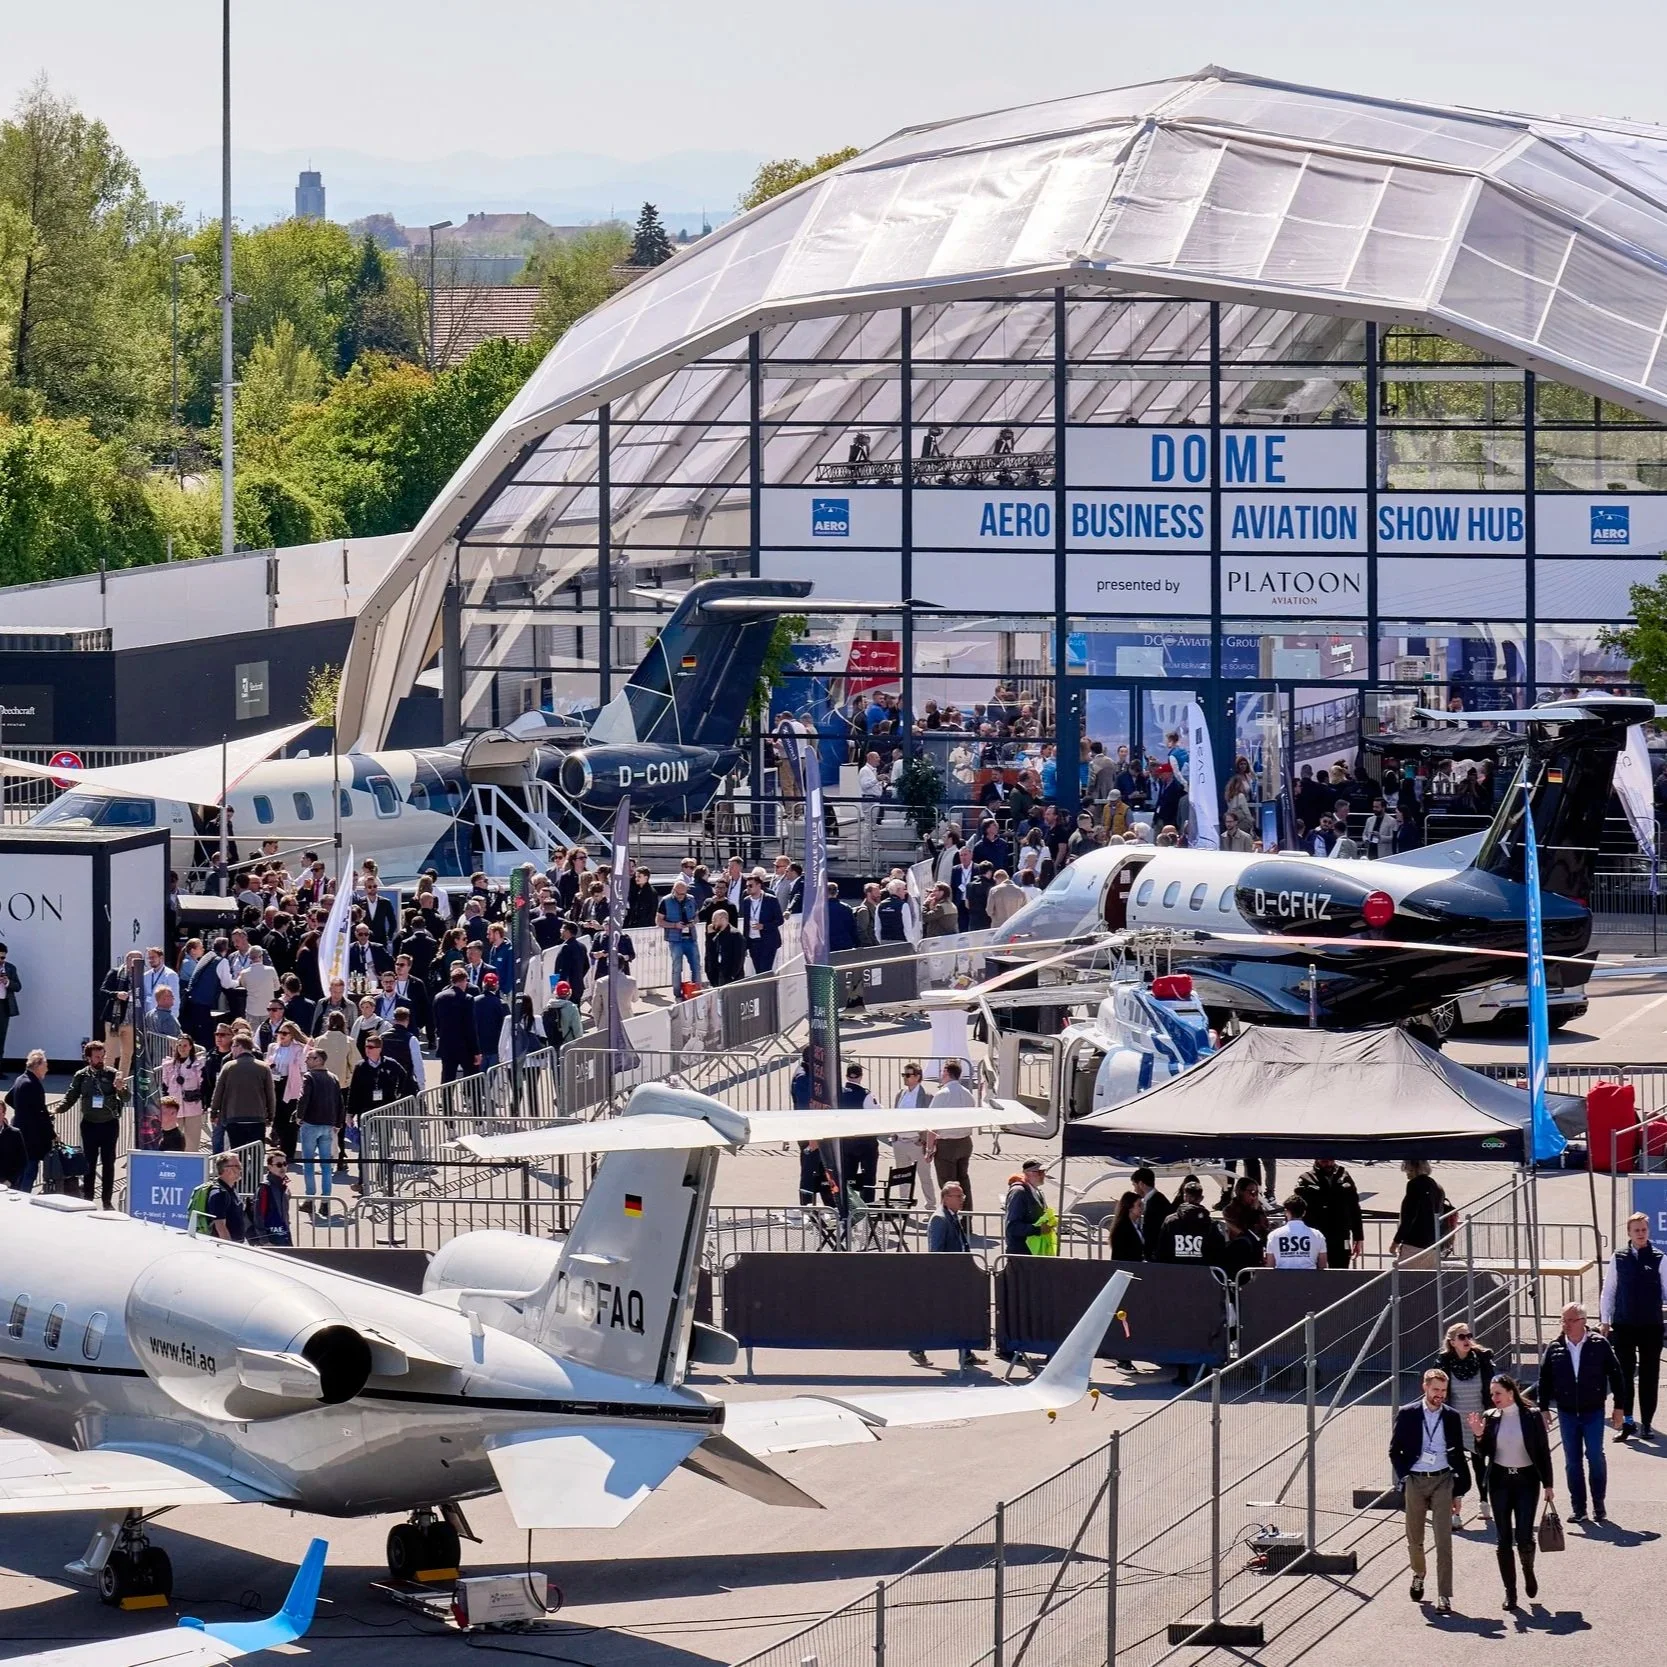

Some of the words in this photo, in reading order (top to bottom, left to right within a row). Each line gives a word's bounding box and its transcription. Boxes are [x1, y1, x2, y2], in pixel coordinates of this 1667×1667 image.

[1151, 434, 1286, 483] DOME
[814, 520, 848, 531] AERO
[980, 502, 1051, 537] AERO
[1072, 503, 1205, 538] BUSINESS
[1231, 505, 1358, 539] AVIATION
[1379, 506, 1460, 541] SHOW
[1468, 507, 1524, 542] HUB
[1593, 528, 1628, 539] AERO
[1096, 579, 1161, 593] presented
[1165, 579, 1180, 594] by
[1228, 571, 1360, 593] PLATOON
[1271, 597, 1318, 605] AVIATION
[1178, 636, 1223, 647] AVIATI
[618, 760, 689, 788] D-COIN
[0, 892, 62, 921] ON
[1255, 888, 1332, 921] D-CFHZ
[151, 1186, 184, 1206] EXIT
[1174, 1234, 1203, 1251] BSG
[1279, 1236, 1311, 1252] BSG
[555, 1271, 645, 1336] D-CFAQ
[149, 1336, 216, 1377] www.fai.ag
